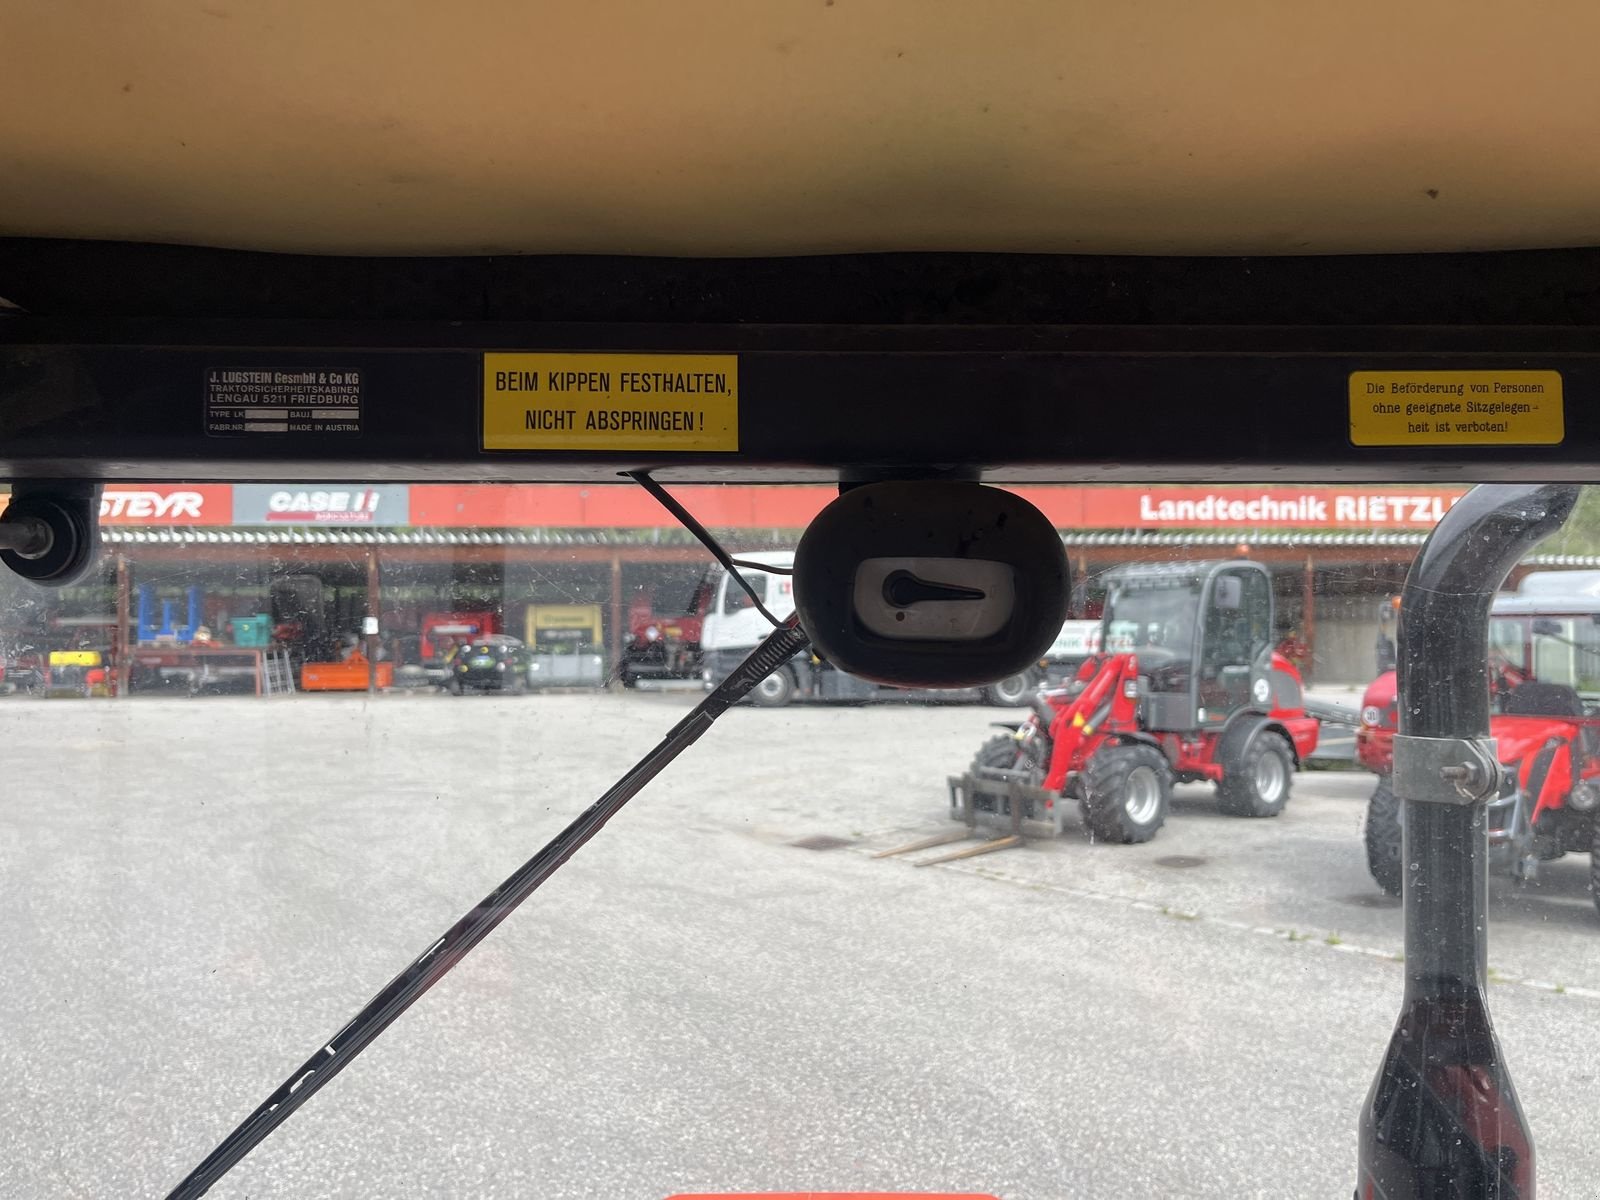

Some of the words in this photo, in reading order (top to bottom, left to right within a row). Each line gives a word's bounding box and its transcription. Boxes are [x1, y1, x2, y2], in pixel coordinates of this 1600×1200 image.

[210, 372, 219, 383] J.
[223, 372, 272, 384] LUGSTEIN
[275, 373, 316, 384] GesmbH
[319, 373, 327, 384] &
[330, 373, 342, 384] Co
[345, 373, 359, 385] KG
[496, 371, 538, 392] BEIM
[549, 372, 610, 392] KIPPEN
[621, 373, 732, 396] FESTHALTEN,
[210, 385, 359, 394] TRAKTORSICHERHEITSKABINEN
[1366, 383, 1385, 394] Die
[1391, 382, 1464, 396] Beförderung
[1470, 385, 1489, 393] von
[1493, 383, 1545, 394] Personen
[210, 394, 258, 403] LENGAU
[263, 395, 287, 404] 5211
[291, 395, 358, 404] FRIEDBURG
[1373, 402, 1400, 413] ohne
[1406, 402, 1461, 415] geeignete
[525, 410, 576, 430] NICHT
[1408, 422, 1429, 433] heit
[1436, 421, 1450, 433] ist
[1455, 421, 1508, 433] verboten!
[270, 491, 350, 512] CASE
[1140, 495, 1328, 521] Landtechnik
